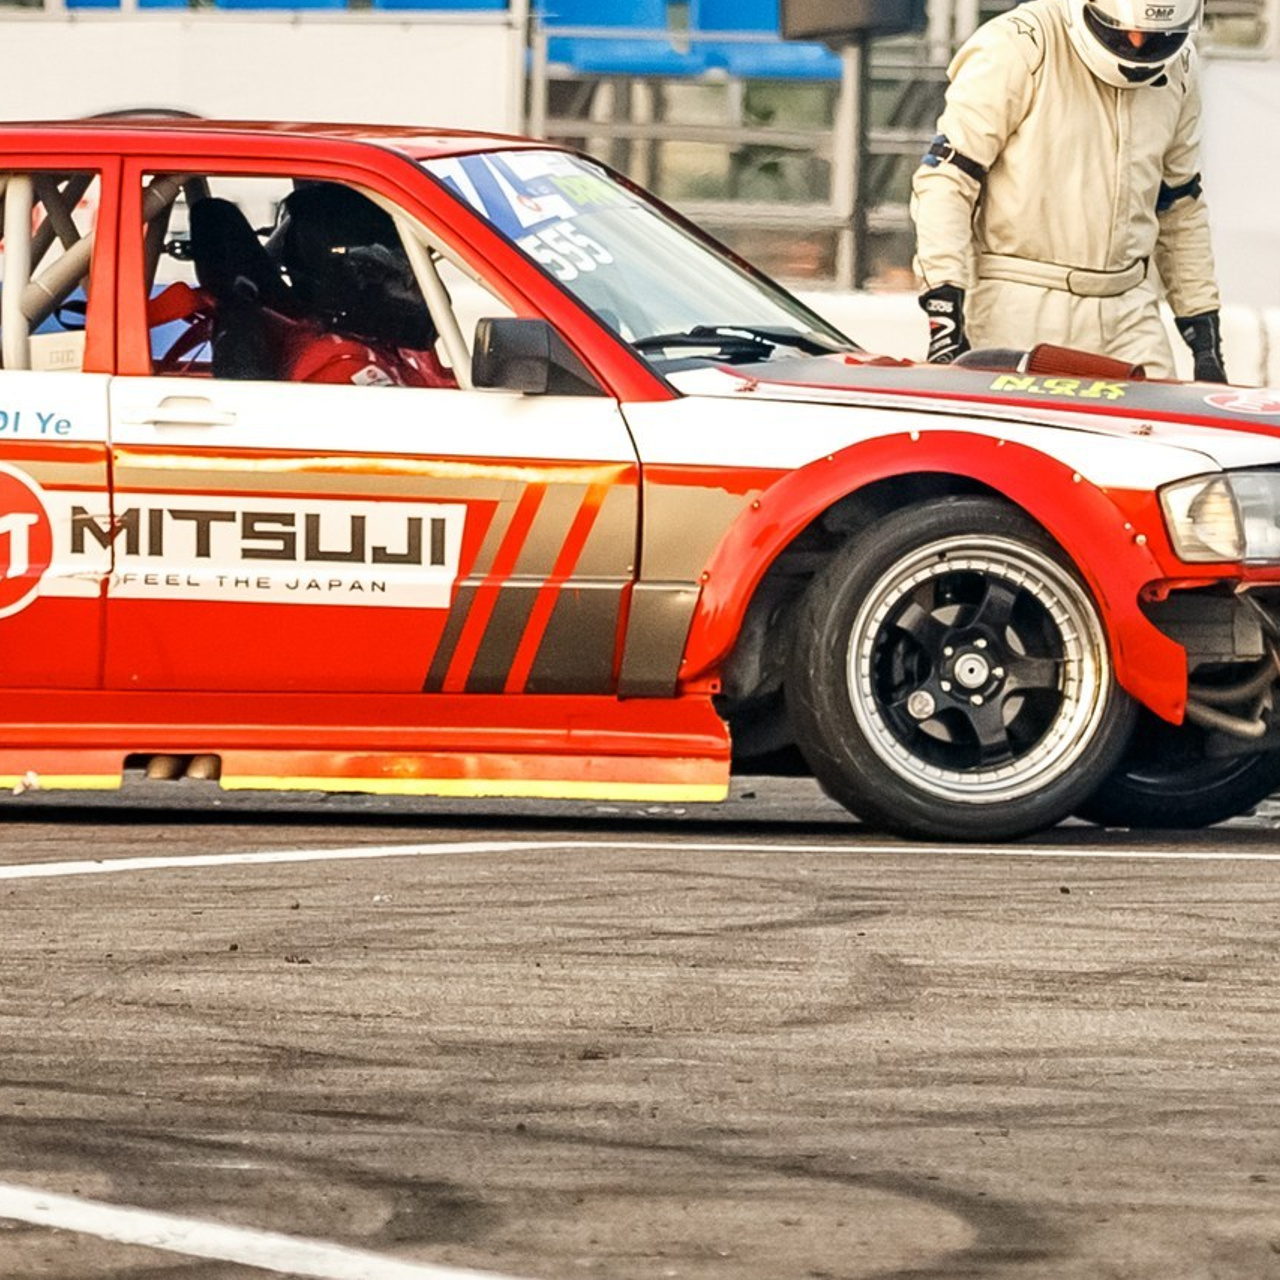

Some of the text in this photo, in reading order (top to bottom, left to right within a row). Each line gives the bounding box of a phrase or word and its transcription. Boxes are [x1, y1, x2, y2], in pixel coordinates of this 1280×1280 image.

[1144, 7, 1175, 19] OMP
[515, 221, 614, 281] 555
[70, 505, 447, 567] MITSUJI
[122, 573, 387, 593] FEEL THE JAPAN
